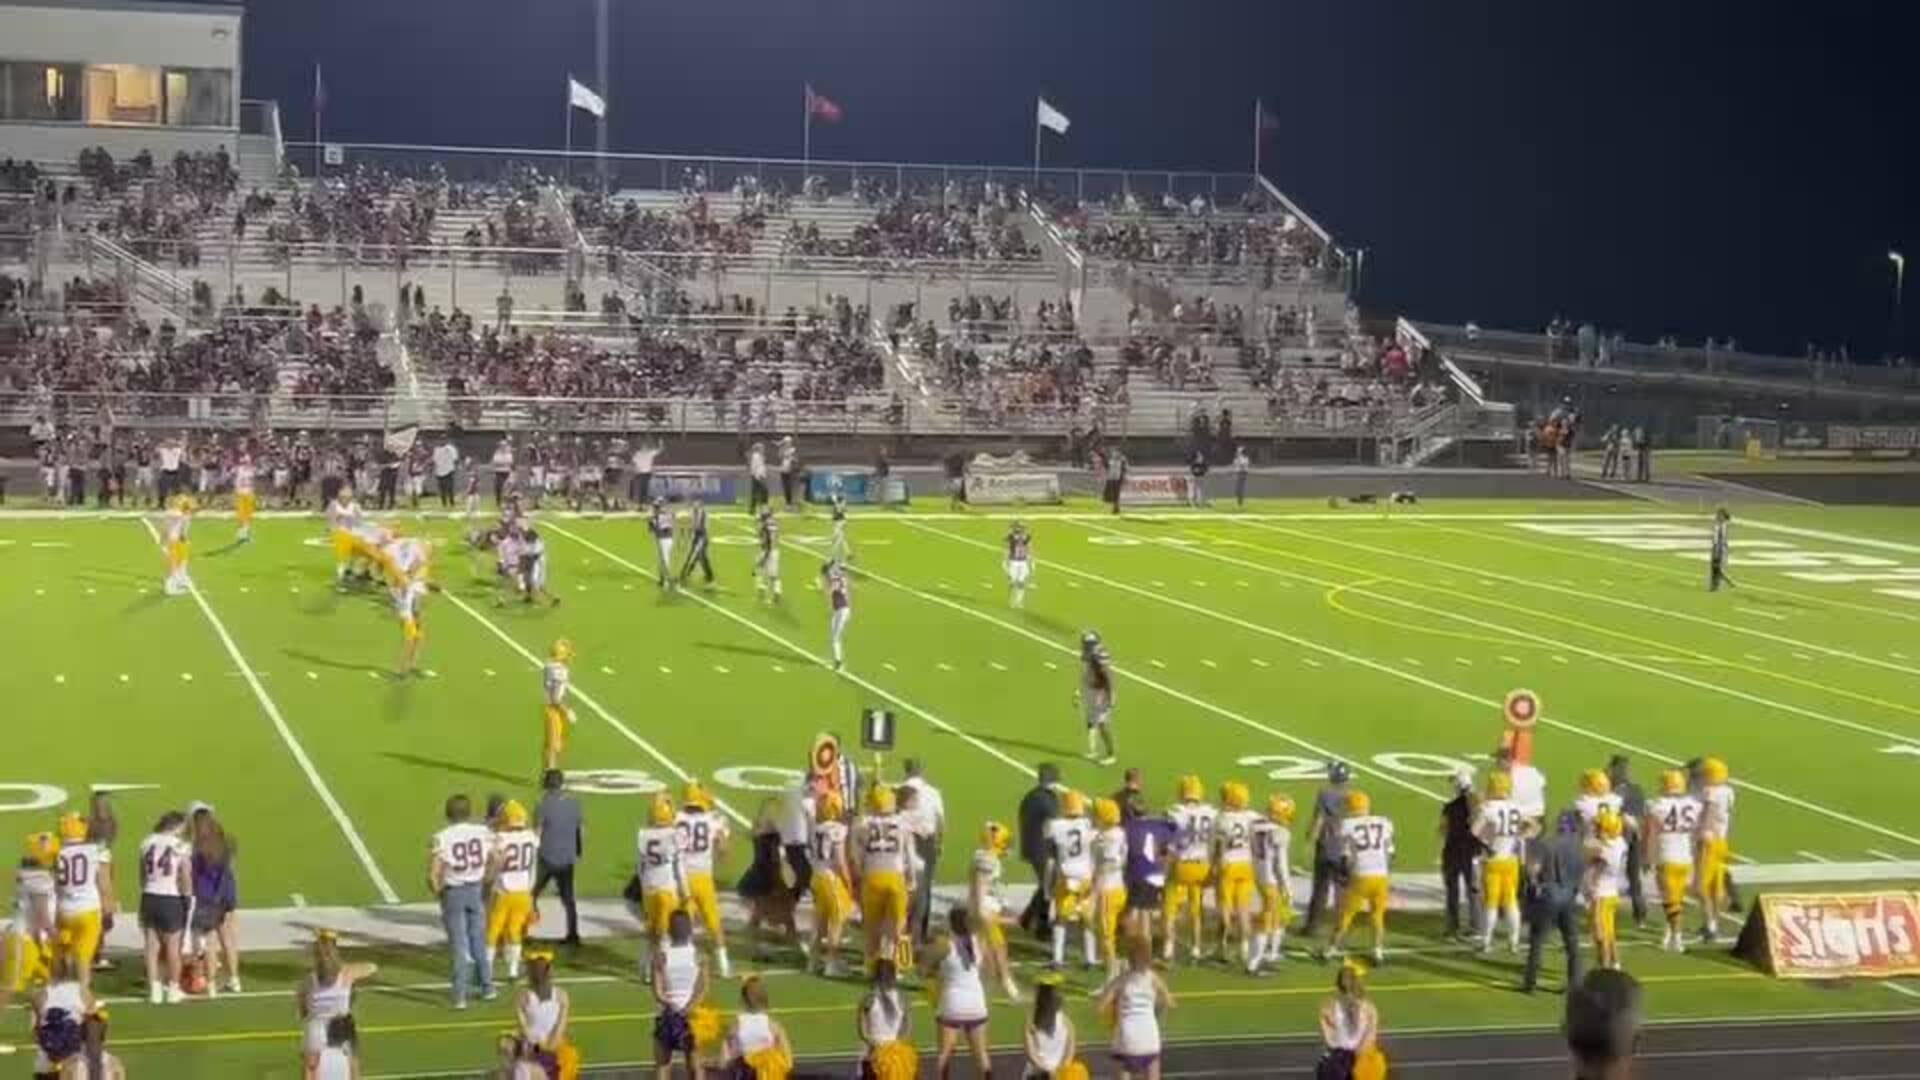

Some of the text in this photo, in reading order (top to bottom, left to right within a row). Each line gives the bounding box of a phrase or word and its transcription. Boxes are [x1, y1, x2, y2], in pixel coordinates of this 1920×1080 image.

[869, 711, 887, 742] 1
[1663, 804, 1697, 832] 45
[1067, 829, 1082, 857] 3
[1354, 824, 1385, 850] 37
[452, 838, 482, 872] 99
[503, 843, 535, 872] 20
